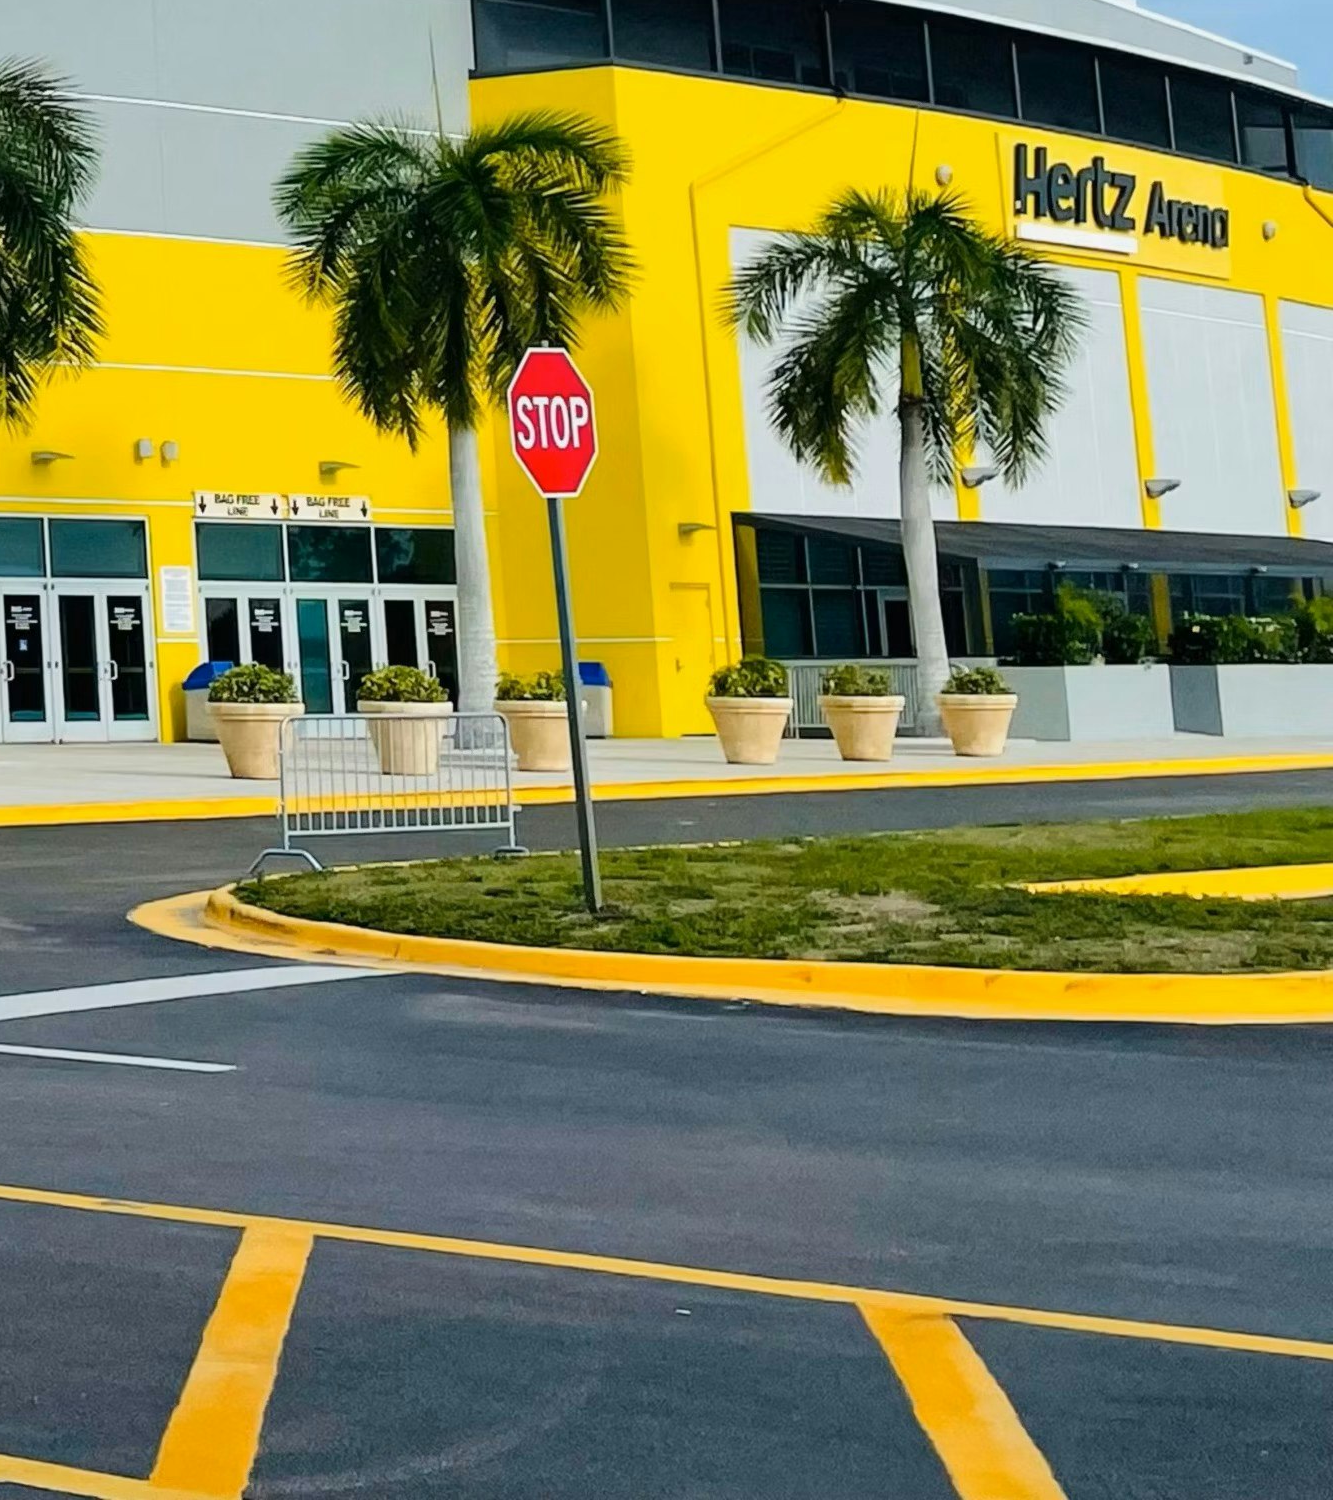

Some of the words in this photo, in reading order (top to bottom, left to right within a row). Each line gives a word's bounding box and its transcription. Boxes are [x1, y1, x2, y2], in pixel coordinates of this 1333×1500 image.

[1014, 143, 1136, 231] Hertz
[1143, 181, 1229, 248] Arena
[516, 395, 589, 449] STOP
[214, 493, 234, 504] BAG
[236, 494, 260, 506] FREE
[306, 496, 325, 507] BAG
[327, 496, 350, 508] FREE
[227, 506, 248, 517] LINE
[318, 509, 339, 519] LINE
